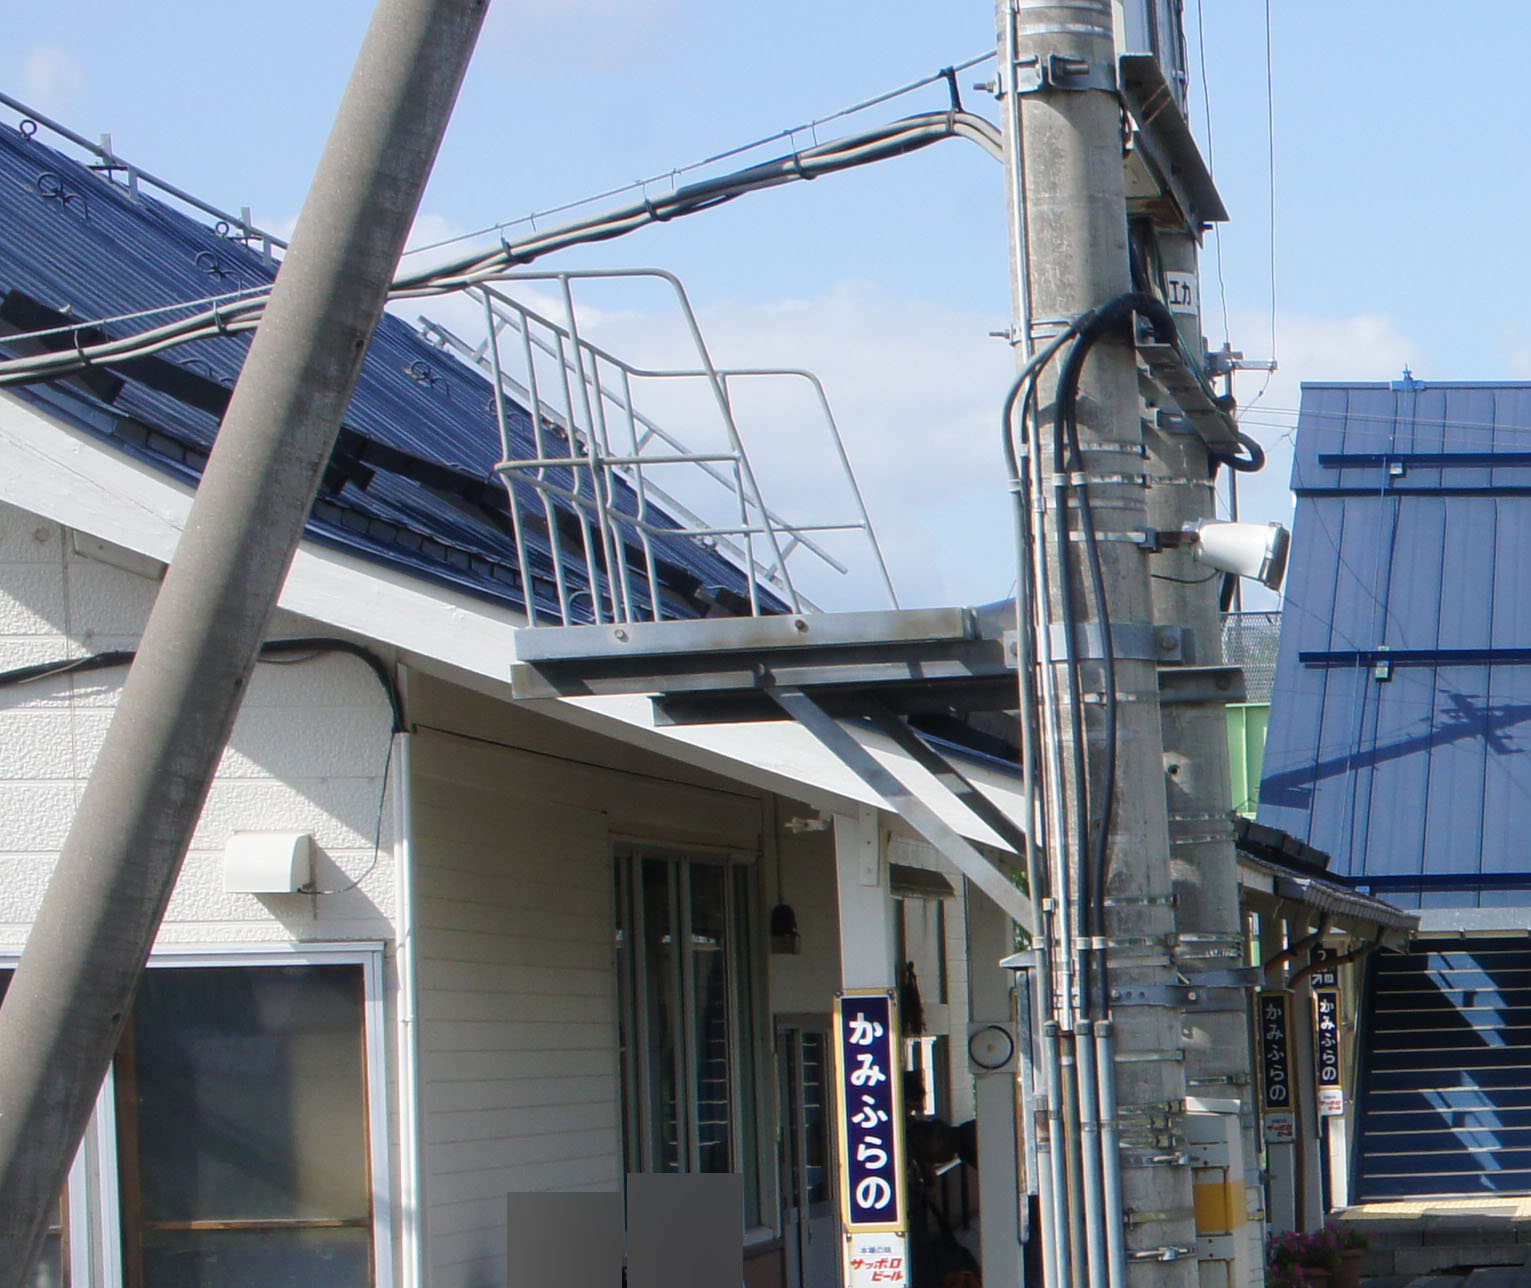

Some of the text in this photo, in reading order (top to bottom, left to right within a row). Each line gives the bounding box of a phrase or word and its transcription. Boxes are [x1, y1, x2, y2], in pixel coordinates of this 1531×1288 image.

[1265, 1003, 1287, 1101] かみふらの
[1319, 998, 1337, 1081] かみふらの
[849, 1012, 891, 1210] かみふらの
[850, 1257, 903, 1270] サッポロ
[871, 1270, 905, 1282] ビール
